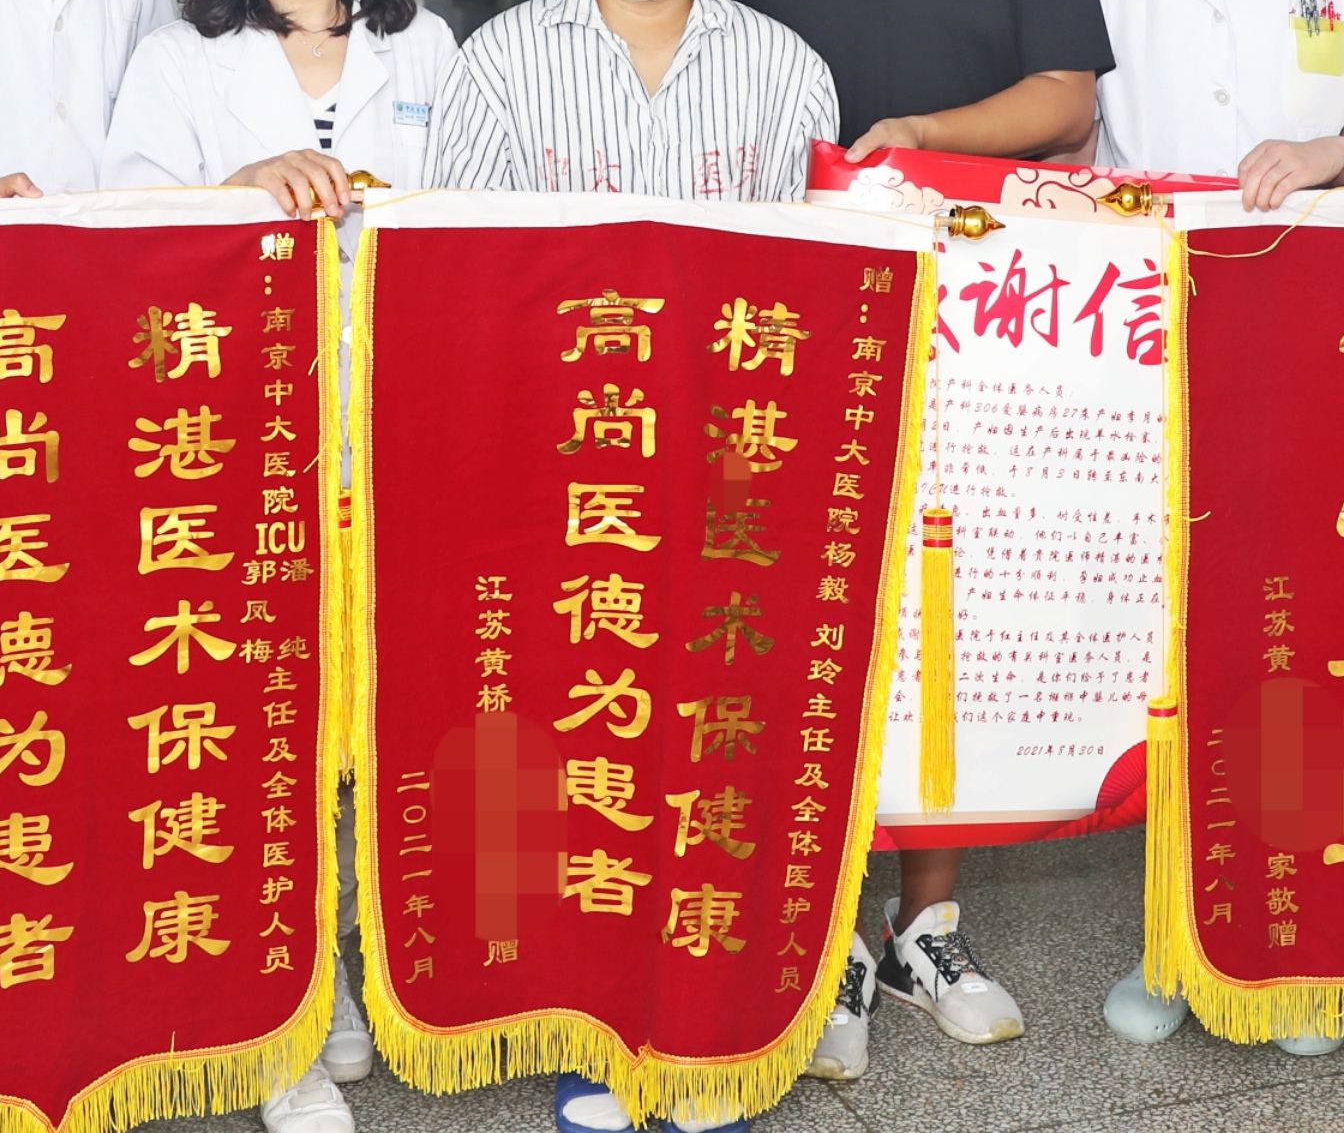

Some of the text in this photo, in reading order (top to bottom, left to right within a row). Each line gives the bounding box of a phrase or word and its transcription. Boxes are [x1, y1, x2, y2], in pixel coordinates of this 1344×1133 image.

[126, 302, 236, 965] 精湛医术保健康
[239, 560, 276, 663] 郭凤梅
[474, 575, 513, 713] 江苏黄桥
[552, 288, 666, 916] 高尚医德为患者
[662, 297, 811, 957] 精湛医术保健康
[1262, 576, 1295, 672] 江苏黄
[259, 667, 297, 974] 主任及全体医护人员
[773, 623, 844, 994] 刘玲主任及全体医护人员
